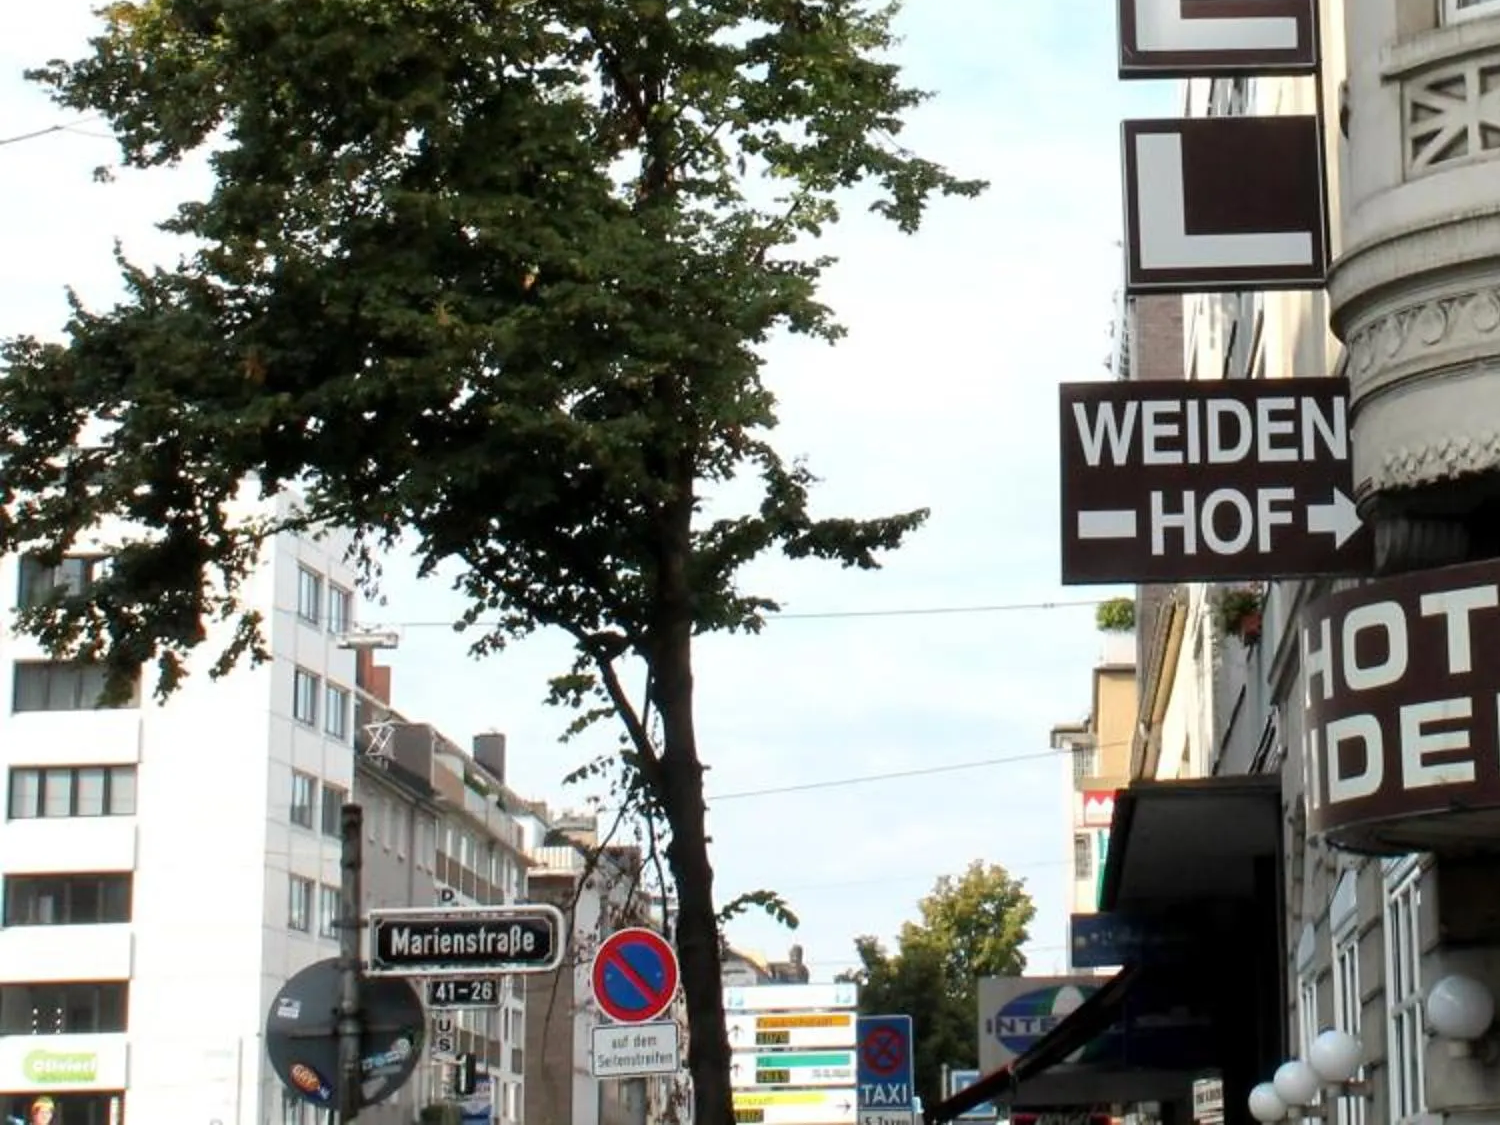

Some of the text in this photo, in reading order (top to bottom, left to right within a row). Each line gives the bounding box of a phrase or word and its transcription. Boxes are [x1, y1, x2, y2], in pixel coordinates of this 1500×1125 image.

[1072, 395, 1348, 467] WEIDEN
[1150, 487, 1295, 556] HOF
[390, 924, 536, 957] Marienstraße
[435, 982, 493, 1001] 41-26
[861, 1082, 908, 1105] TAXI
